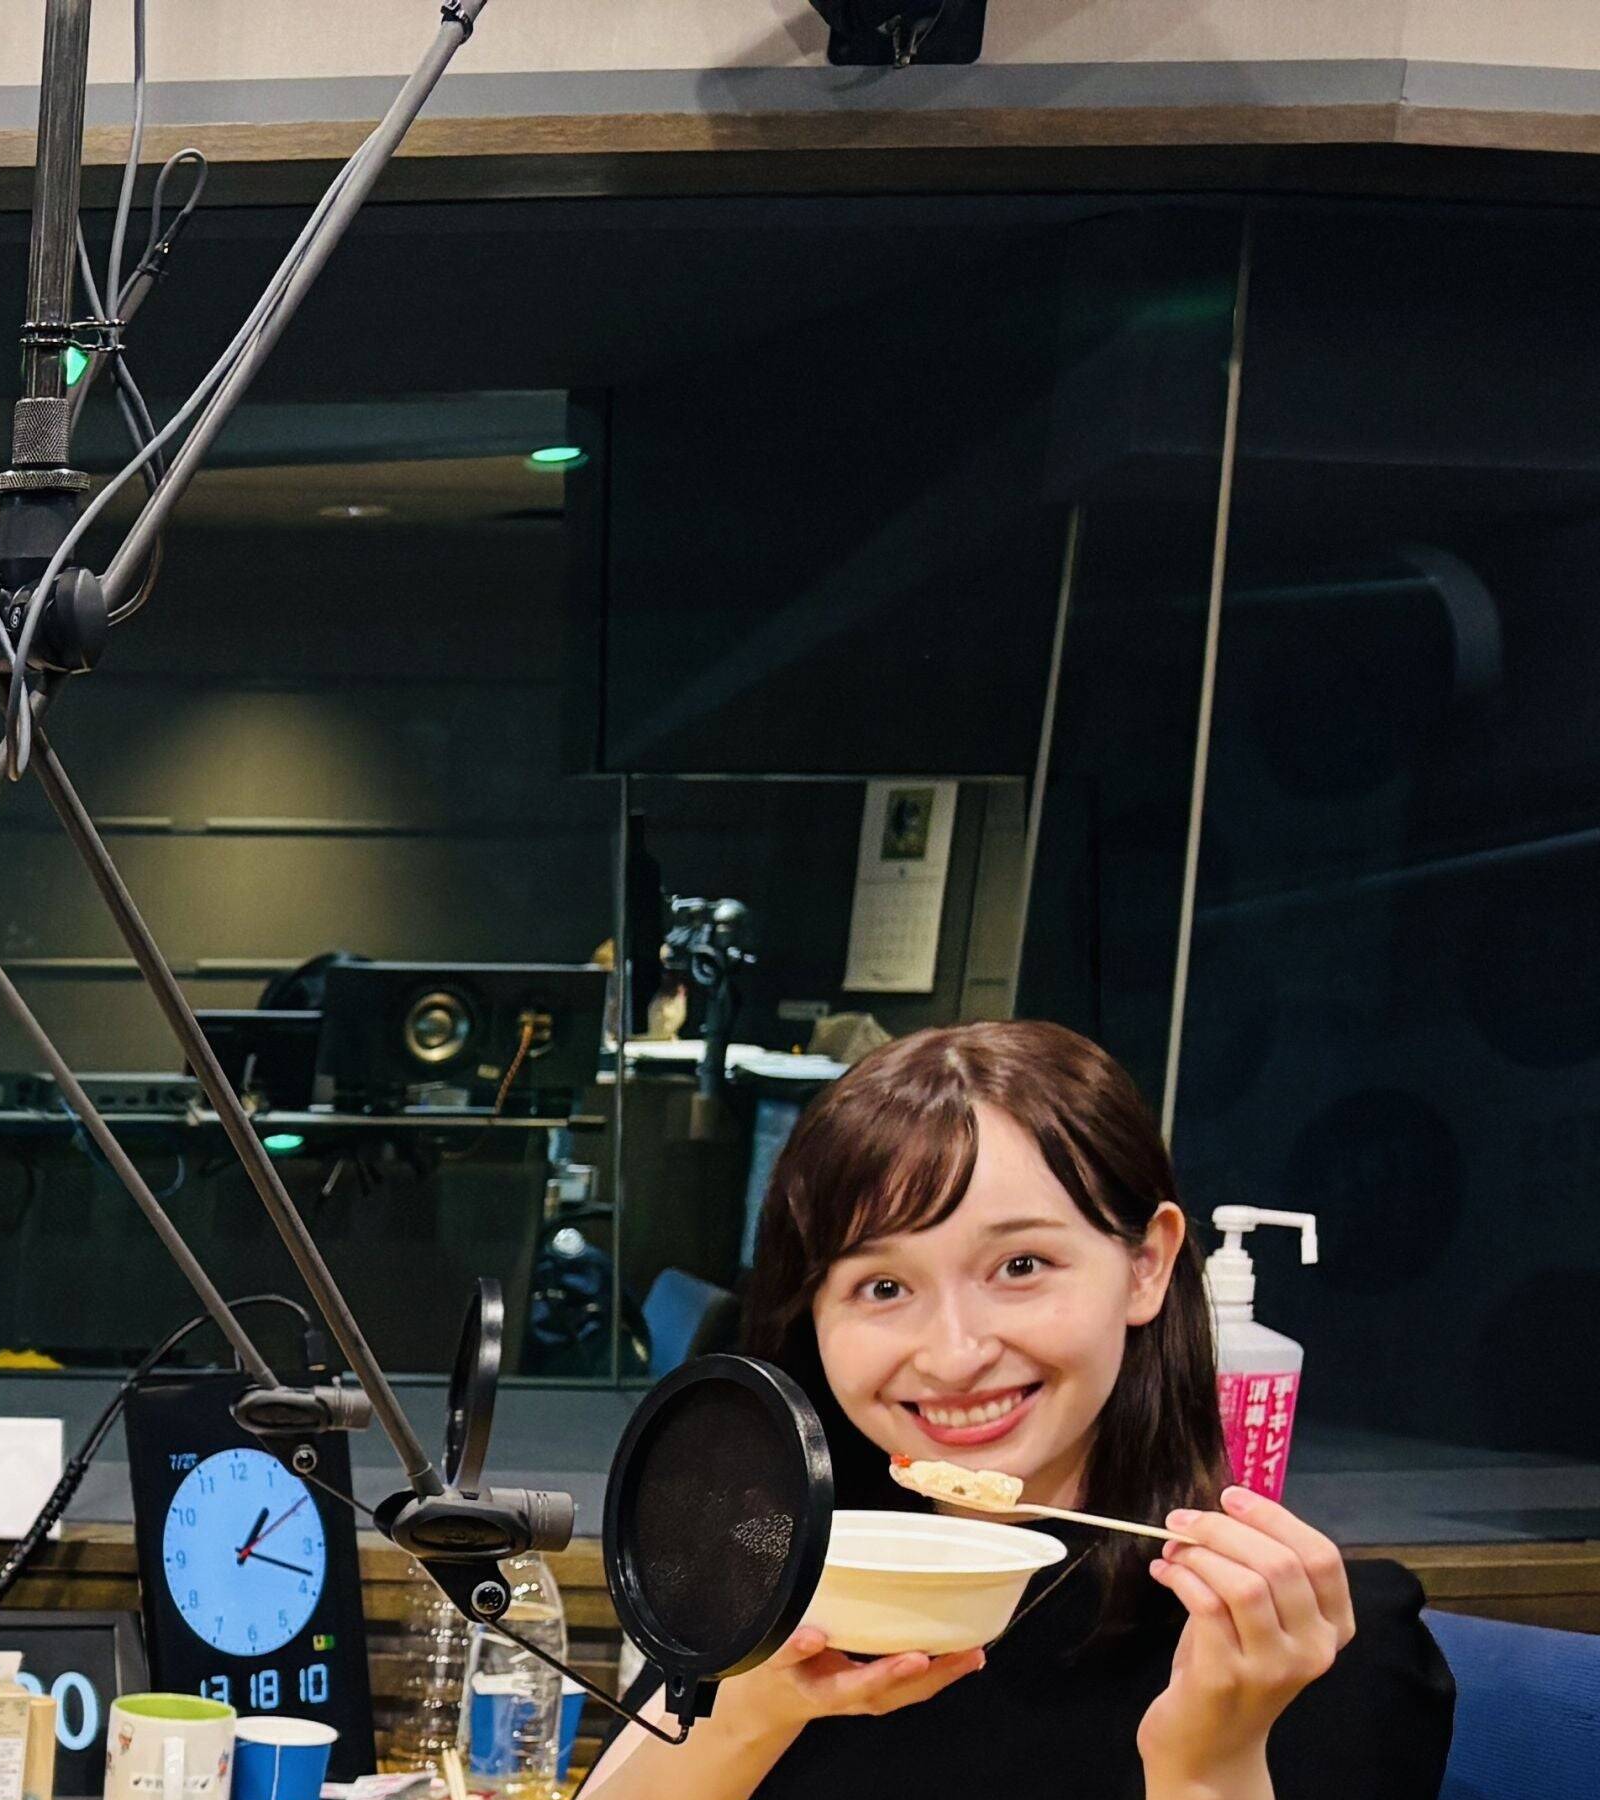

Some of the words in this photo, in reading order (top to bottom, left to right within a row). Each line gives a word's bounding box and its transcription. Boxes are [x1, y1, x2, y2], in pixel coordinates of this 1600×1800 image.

[229, 1461, 248, 1481] 12
[178, 1508, 196, 1527] 10
[175, 1553, 186, 1569] 9
[250, 1669, 279, 1709] 18
[300, 1663, 329, 1704] 10
